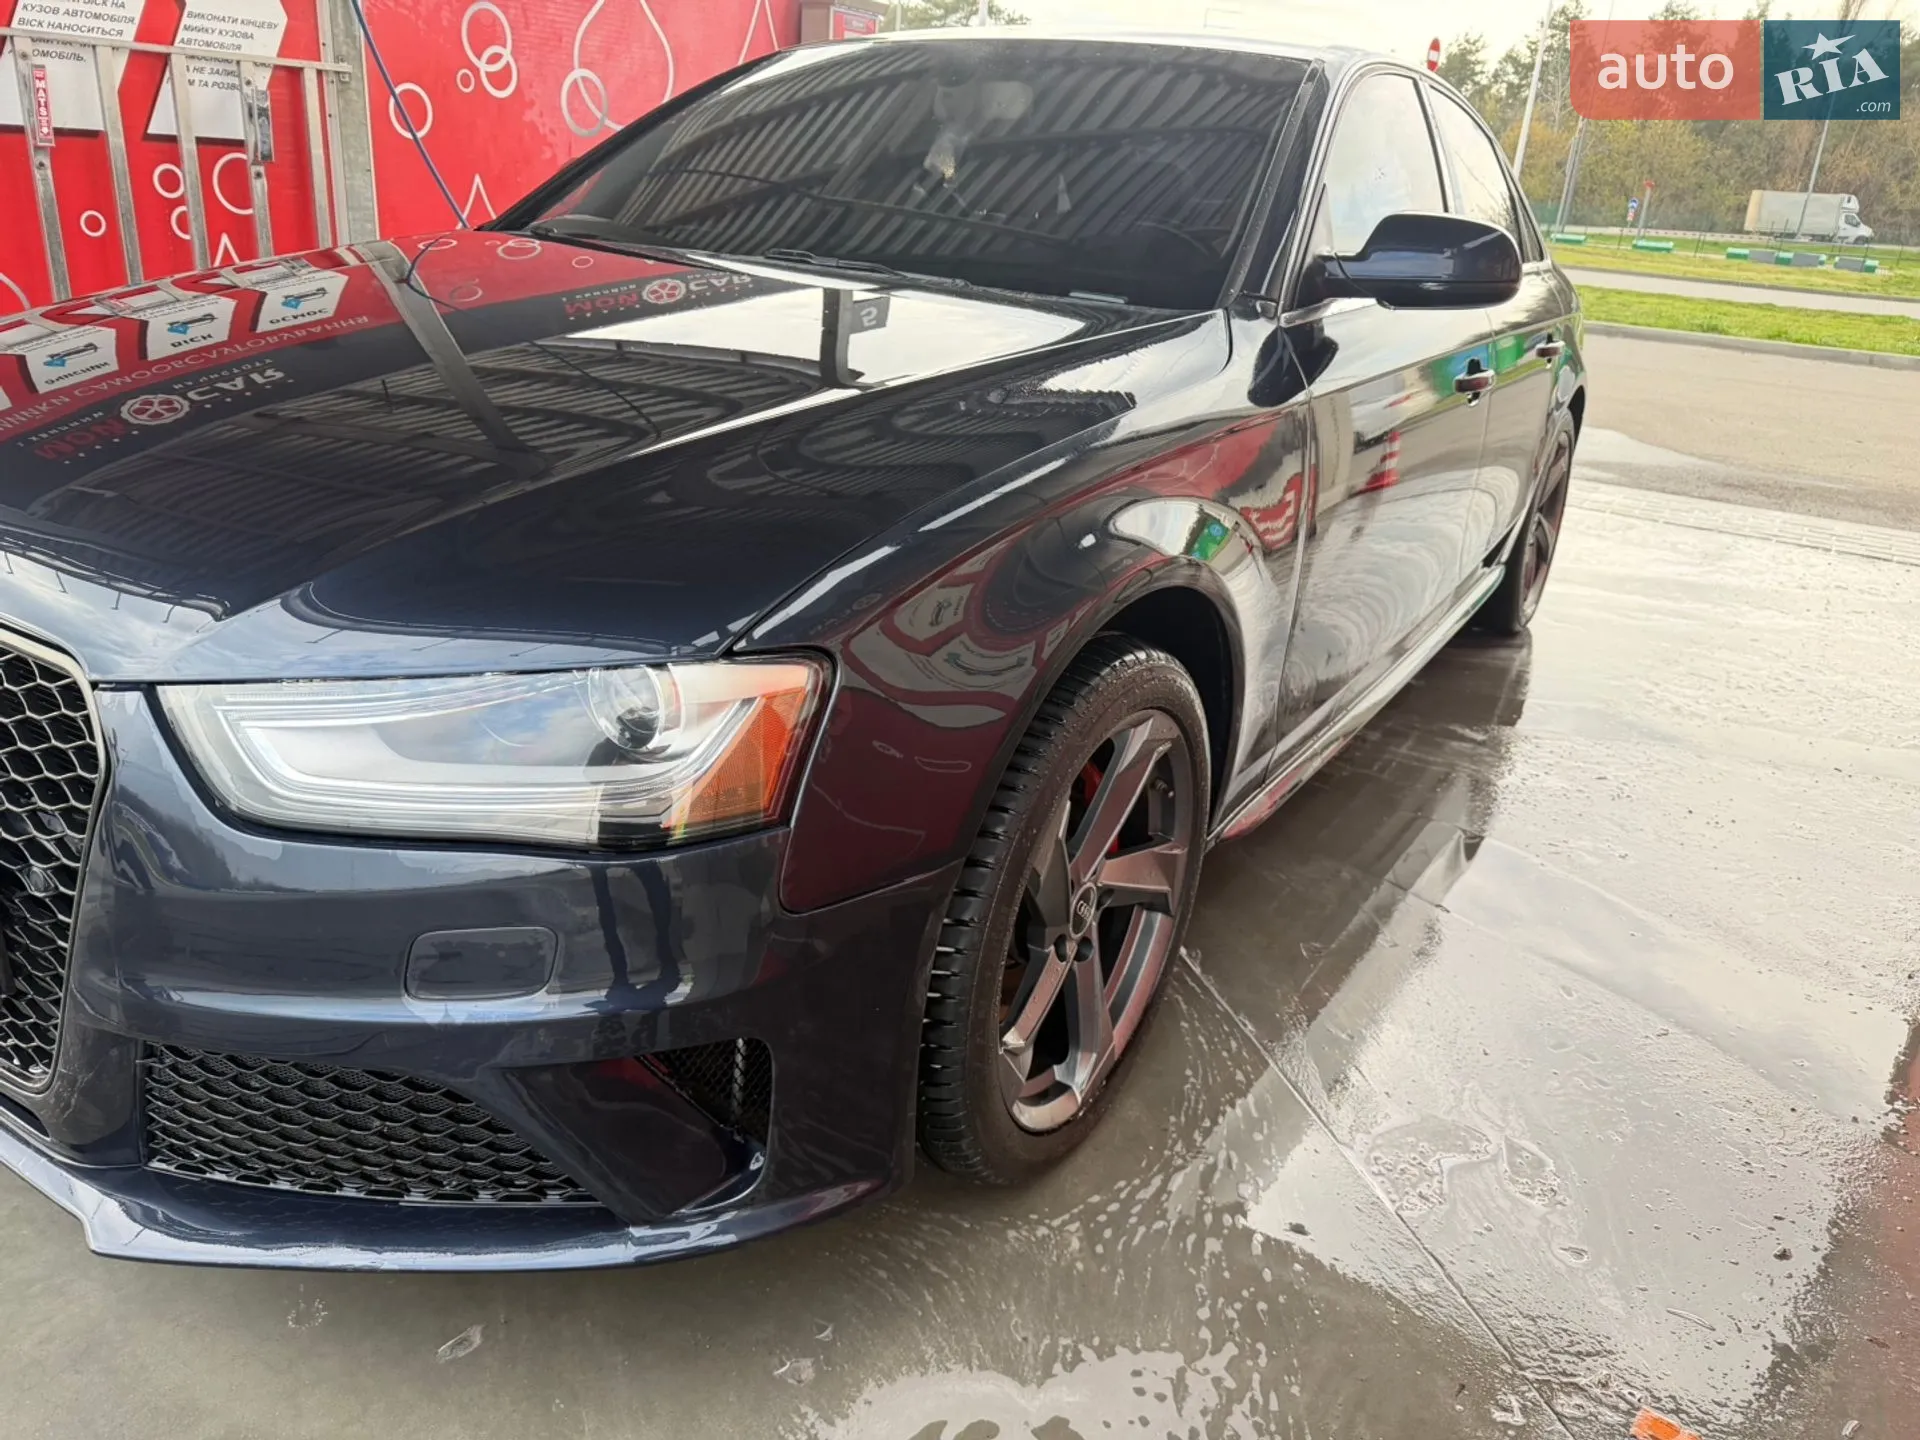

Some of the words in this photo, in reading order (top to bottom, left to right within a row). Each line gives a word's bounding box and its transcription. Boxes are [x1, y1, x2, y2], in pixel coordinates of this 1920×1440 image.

[21, 3, 60, 15] КУЗОВ
[62, 8, 136, 24] АВТОМОБІЛЯ.
[186, 10, 239, 25] ВИКОНАТИ
[240, 18, 279, 30] КІНЦЕВУ
[17, 17, 45, 28] ВІСК
[46, 21, 124, 37] НАНОСИТЬСЯ
[182, 24, 216, 35] МИЙКУ
[218, 28, 255, 40] КУЗОВА
[178, 37, 242, 51] АВТОМОБІЛЯ
[192, 66, 205, 75] НЕ
[198, 79, 209, 88] ТА
